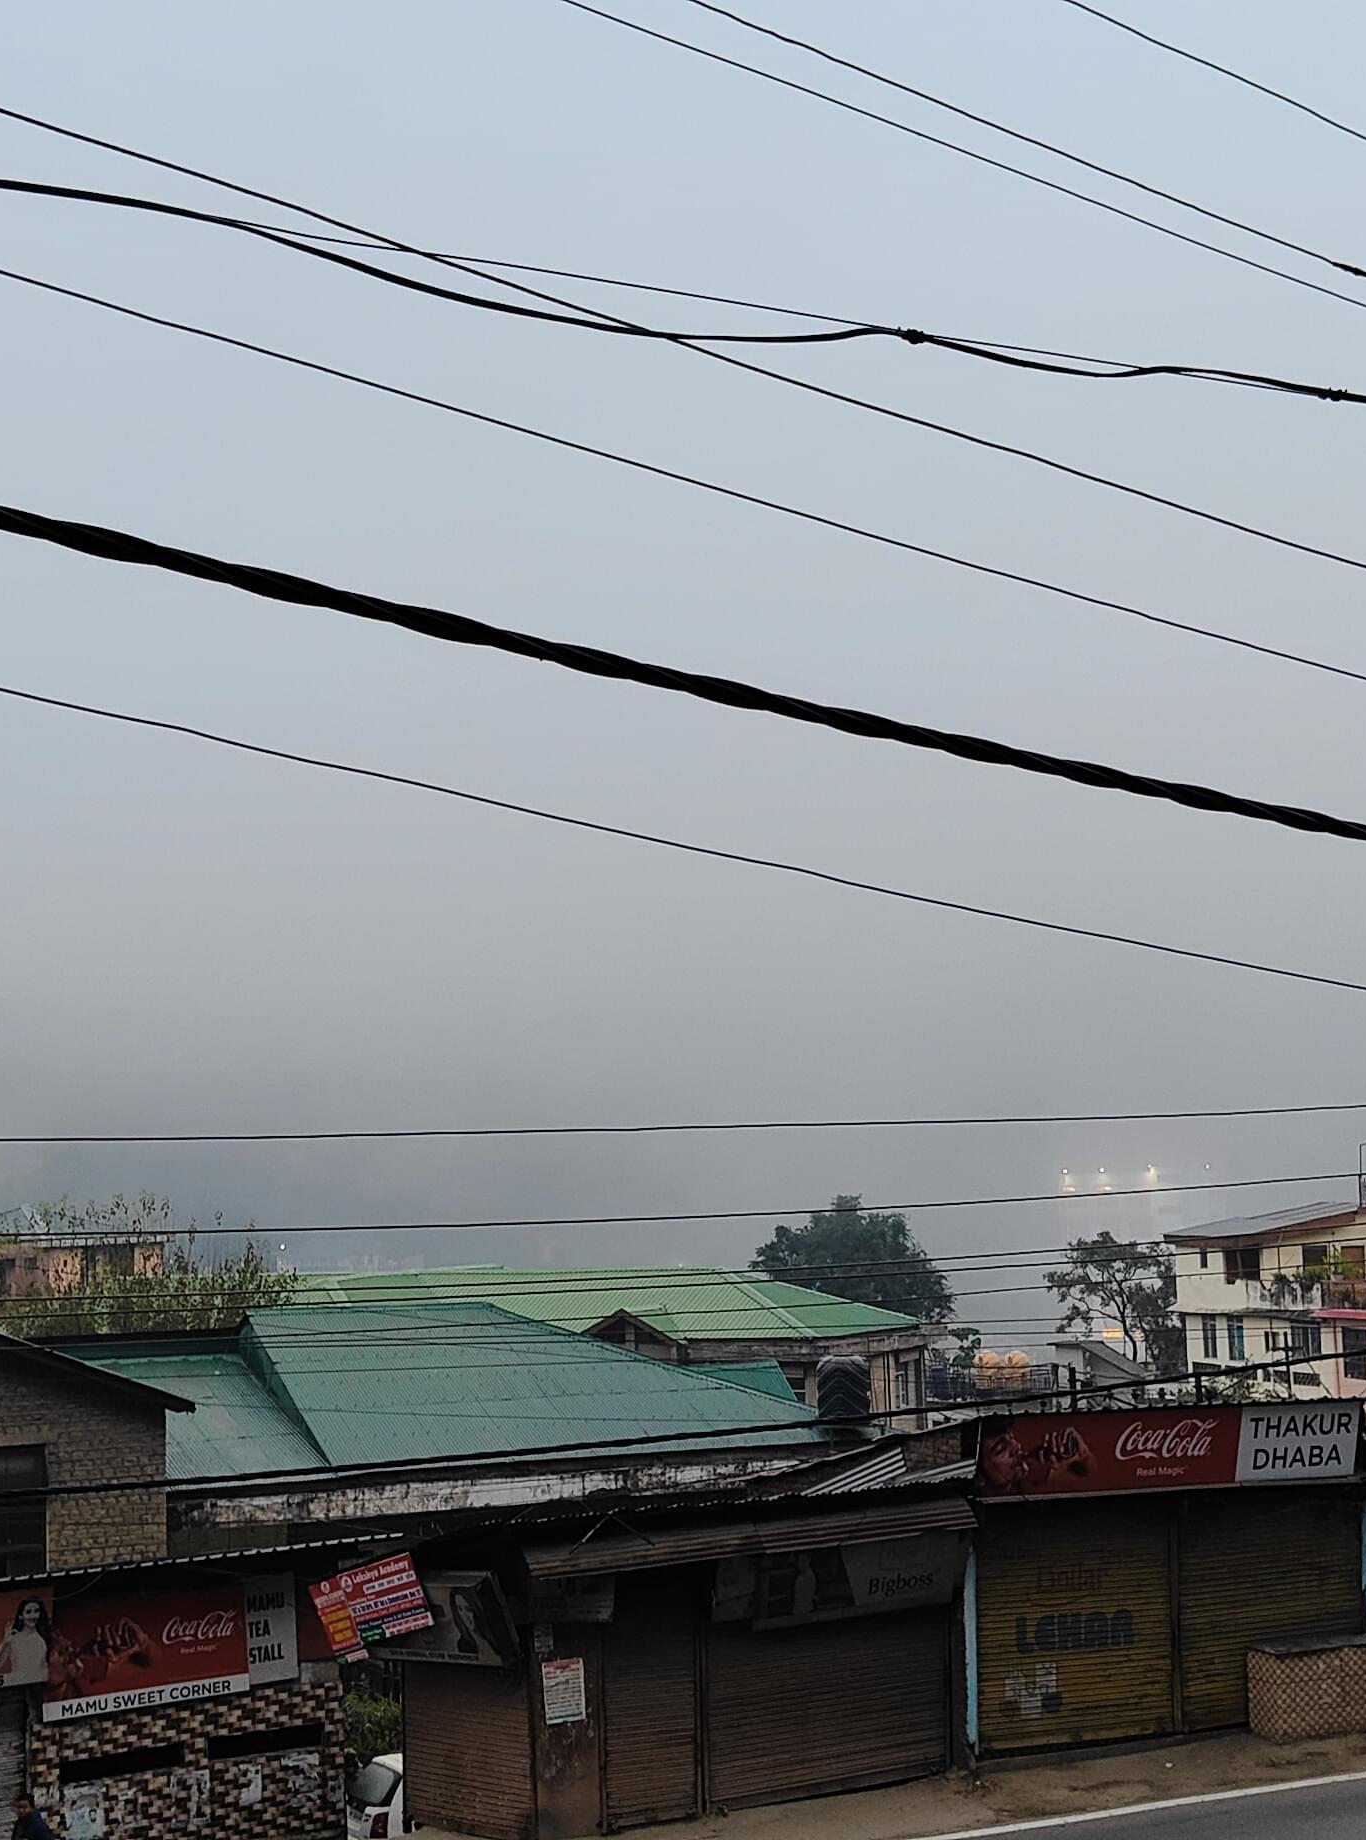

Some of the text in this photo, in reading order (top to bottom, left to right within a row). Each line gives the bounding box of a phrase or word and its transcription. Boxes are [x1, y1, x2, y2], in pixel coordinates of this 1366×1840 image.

[1250, 1413, 1353, 1439] THAKUR
[1115, 1418, 1219, 1461] Coca-Cola
[1252, 1444, 1342, 1470] DHABA
[1136, 1465, 1185, 1477] Real Magic
[868, 1572, 934, 1597] Bigboss
[247, 1592, 285, 1613] MAMU
[162, 1607, 238, 1646] Coca-Cola
[248, 1621, 271, 1639] TEA
[248, 1643, 284, 1665] STALL
[61, 1680, 231, 1717] MAMU SWEET CORNER
